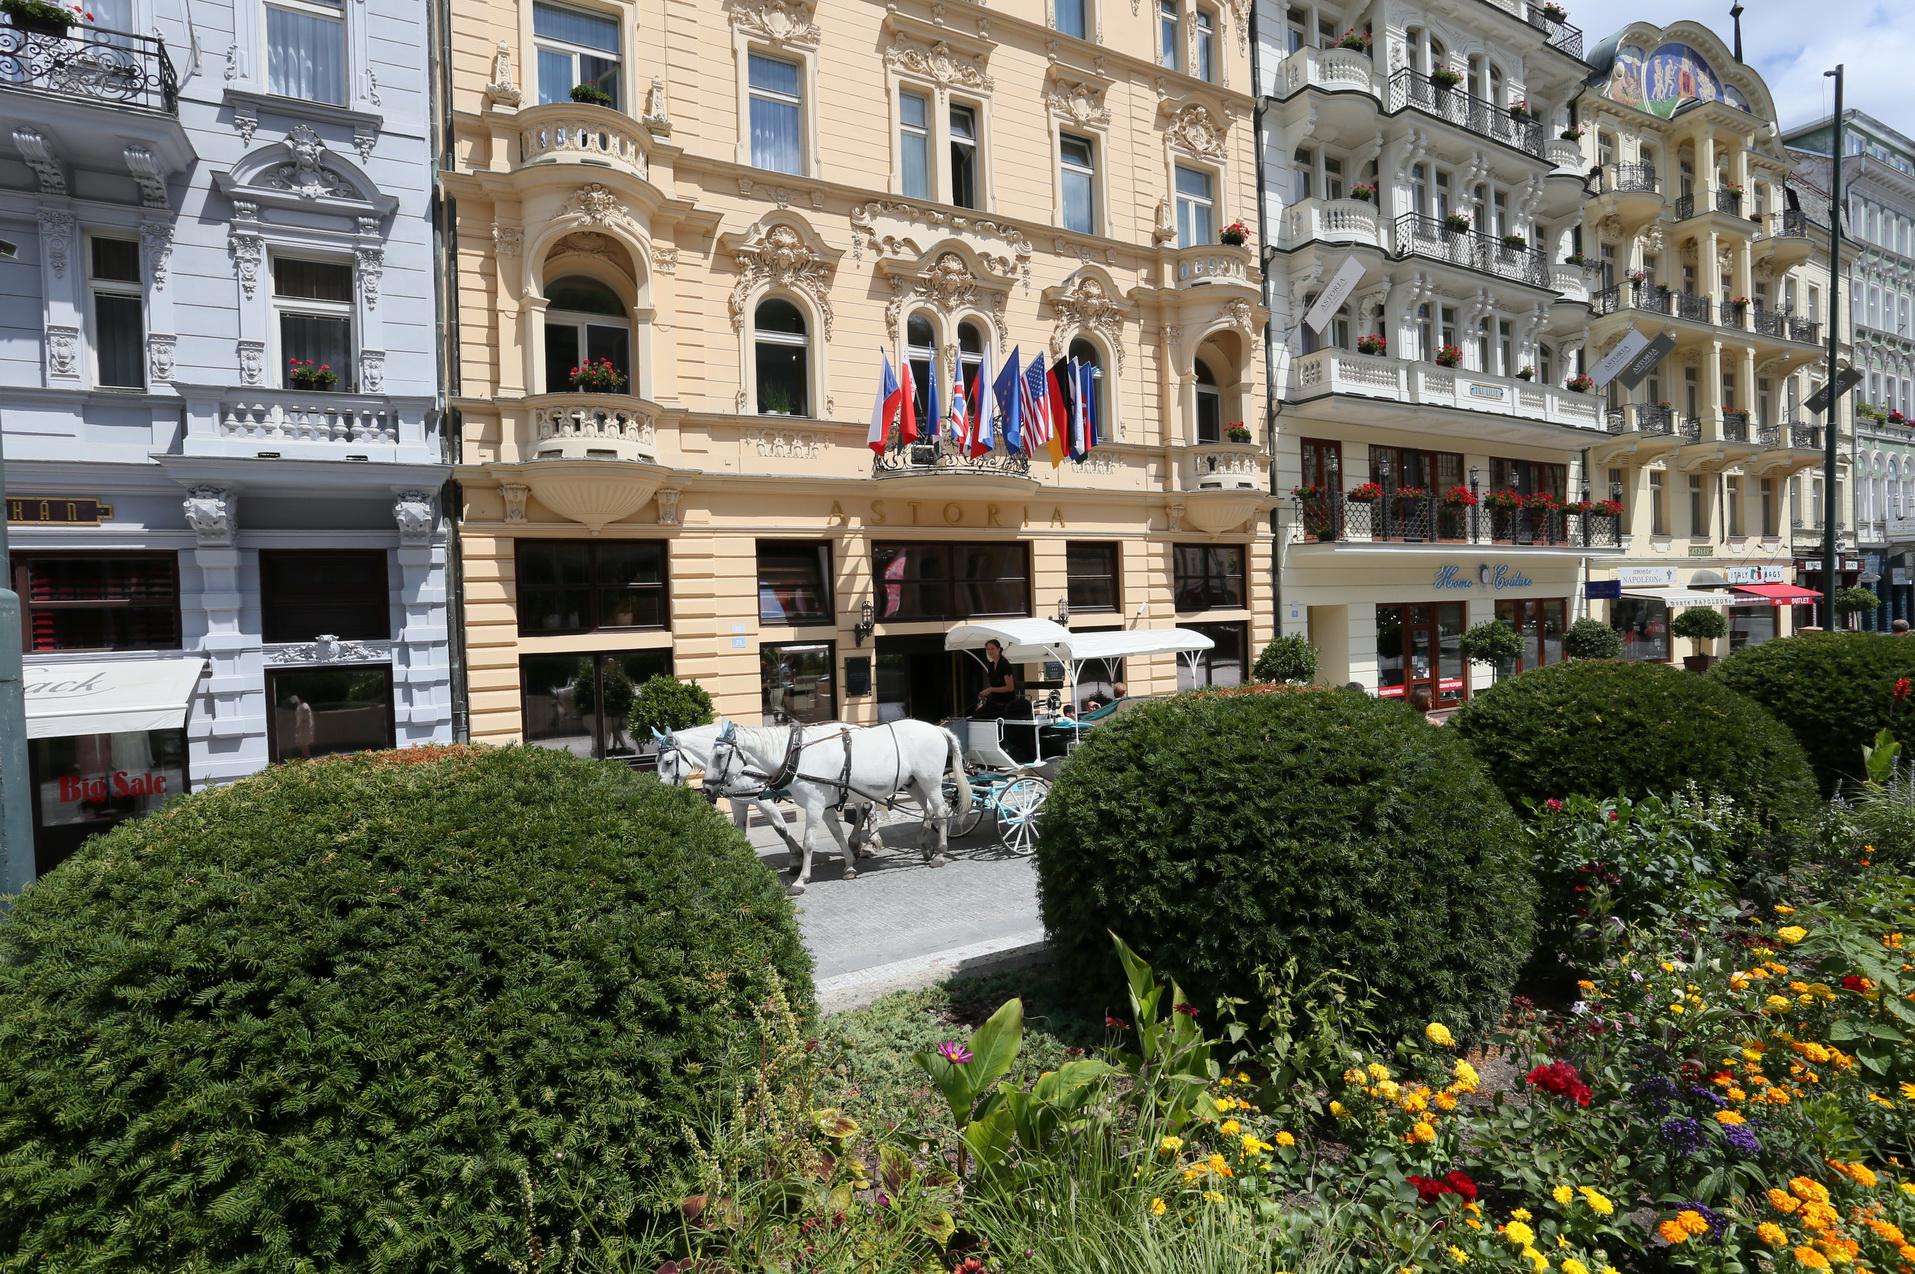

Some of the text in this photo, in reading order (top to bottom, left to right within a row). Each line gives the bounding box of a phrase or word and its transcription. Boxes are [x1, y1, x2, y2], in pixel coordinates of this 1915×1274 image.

[1320, 278, 1346, 312] ASTORIA
[1604, 345, 1630, 371] ASTORIA
[1632, 348, 1657, 374] ASTORIA
[827, 500, 1066, 529] ASTORIA
[1433, 565, 1473, 589] Home
[1730, 570, 1782, 580] ITALY BAGS
[1791, 597, 1810, 605] OUTLET
[58, 768, 168, 805] Big Sale
